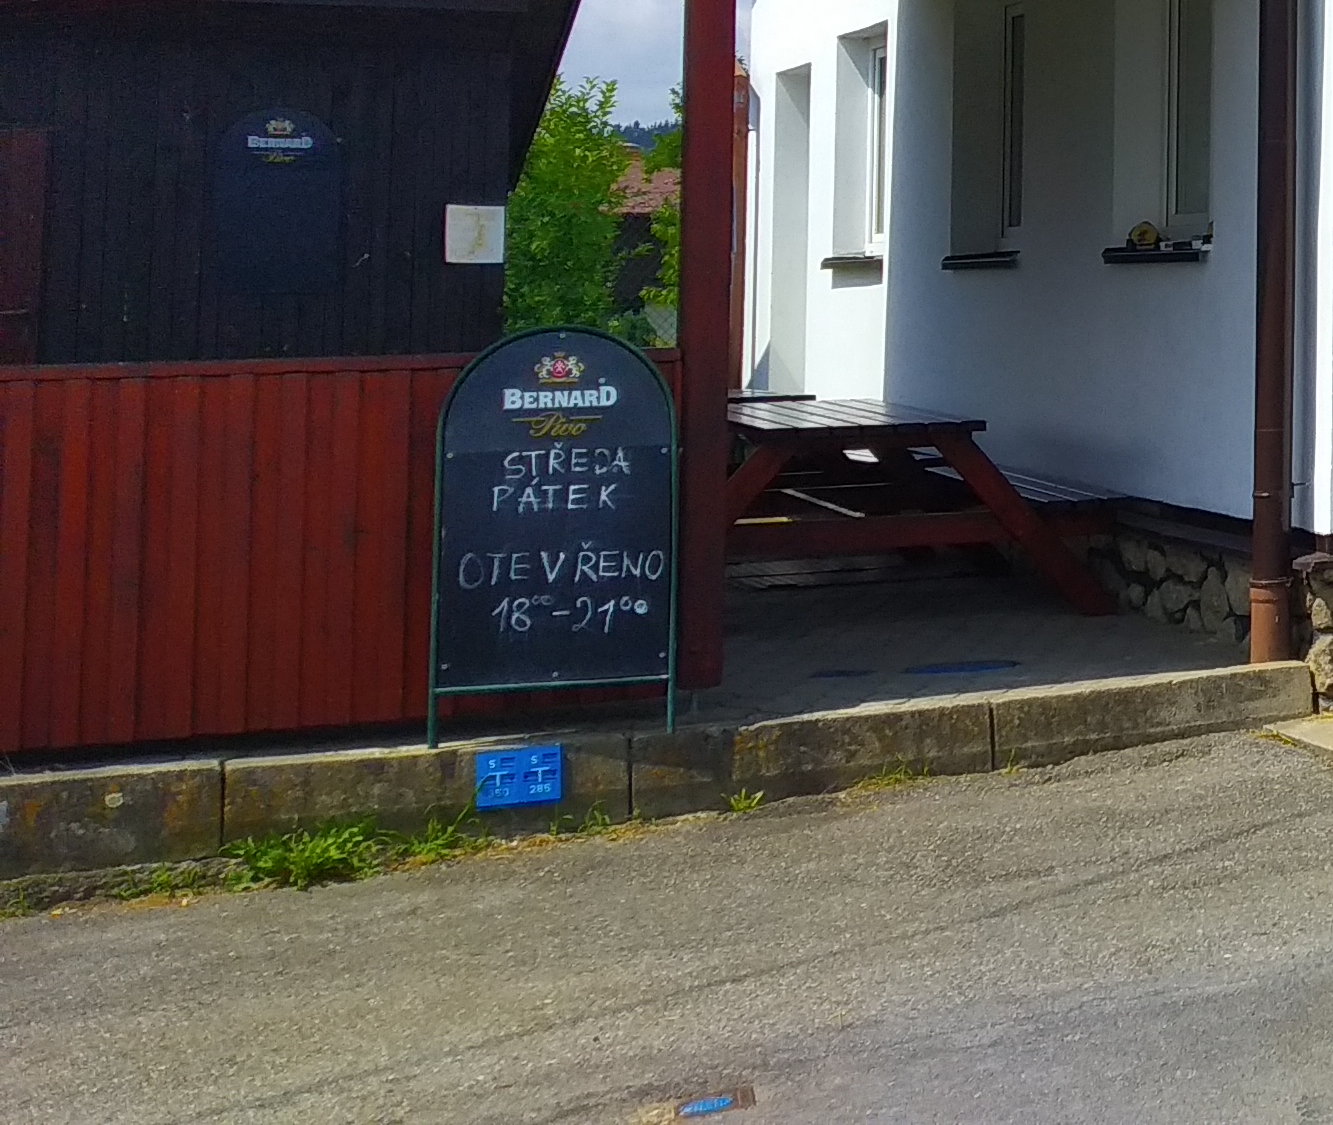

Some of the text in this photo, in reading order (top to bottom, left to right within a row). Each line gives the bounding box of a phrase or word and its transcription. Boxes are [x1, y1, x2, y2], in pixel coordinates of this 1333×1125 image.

[502, 384, 618, 410] BERNARD
[529, 411, 587, 437] Pivo
[503, 441, 631, 479] STŘEDA
[492, 477, 618, 513] PÁTEK
[529, 783, 552, 795] 285
